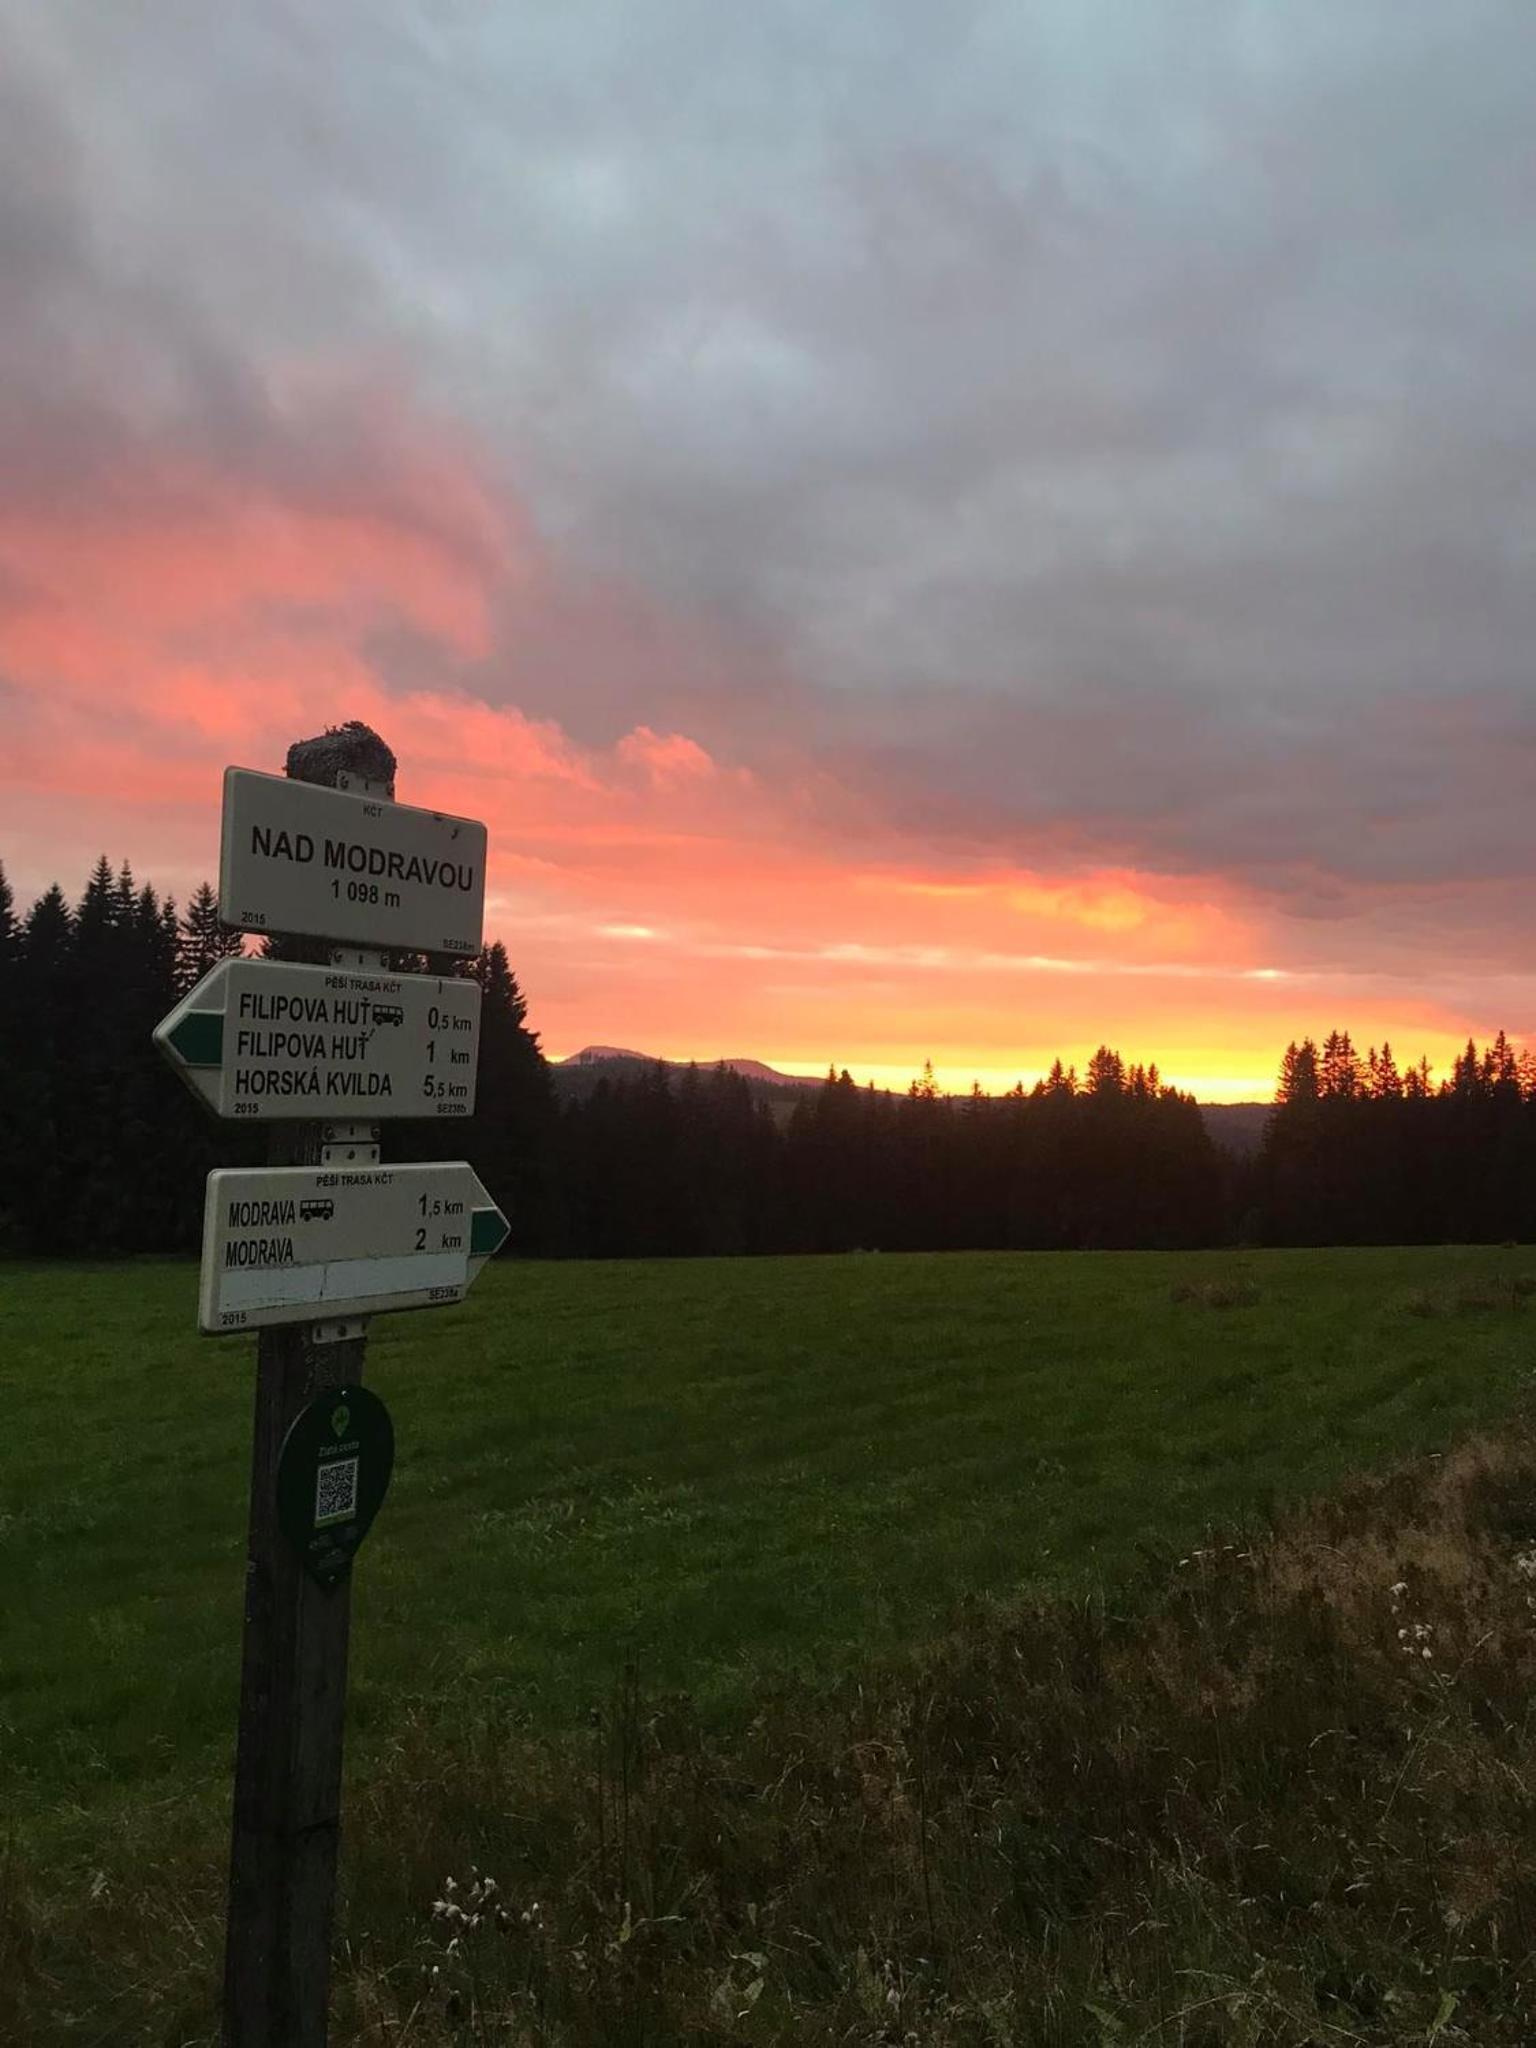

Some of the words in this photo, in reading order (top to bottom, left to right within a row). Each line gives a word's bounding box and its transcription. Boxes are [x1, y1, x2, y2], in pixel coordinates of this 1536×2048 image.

[251, 825, 314, 863] NAD
[324, 839, 473, 891] MODRAVOU
[331, 879, 339, 898] 1
[347, 881, 379, 904] 098
[384, 891, 400, 907] m
[241, 911, 266, 925] 2015
[325, 975, 348, 989] PĚŠÍ
[350, 979, 381, 992] TRASA
[239, 993, 329, 1023] FILIPOVA
[332, 997, 371, 1025] HUŤ
[428, 1007, 449, 1030] 0,5
[453, 1016, 472, 1031] km
[237, 1031, 326, 1059] FILIPOVA
[331, 1031, 369, 1060] HUŤ
[426, 1041, 435, 1063] 1
[451, 1048, 470, 1064] km
[235, 1066, 320, 1095] HORSKÁ
[326, 1072, 393, 1096] KVILDA
[423, 1075, 445, 1097] 5,5
[448, 1082, 467, 1097] km
[234, 1102, 259, 1114] 2015
[315, 1174, 339, 1187] PĚŠÍ
[341, 1174, 372, 1186] TRASA
[374, 1173, 394, 1185] KČT
[228, 1200, 296, 1228] MODRAVA
[418, 1193, 440, 1218] 1,5
[443, 1200, 463, 1215] km
[415, 1228, 426, 1250] 2
[442, 1234, 462, 1249] km
[226, 1238, 293, 1267] MODRAVA
[222, 1312, 247, 1325] 2015
